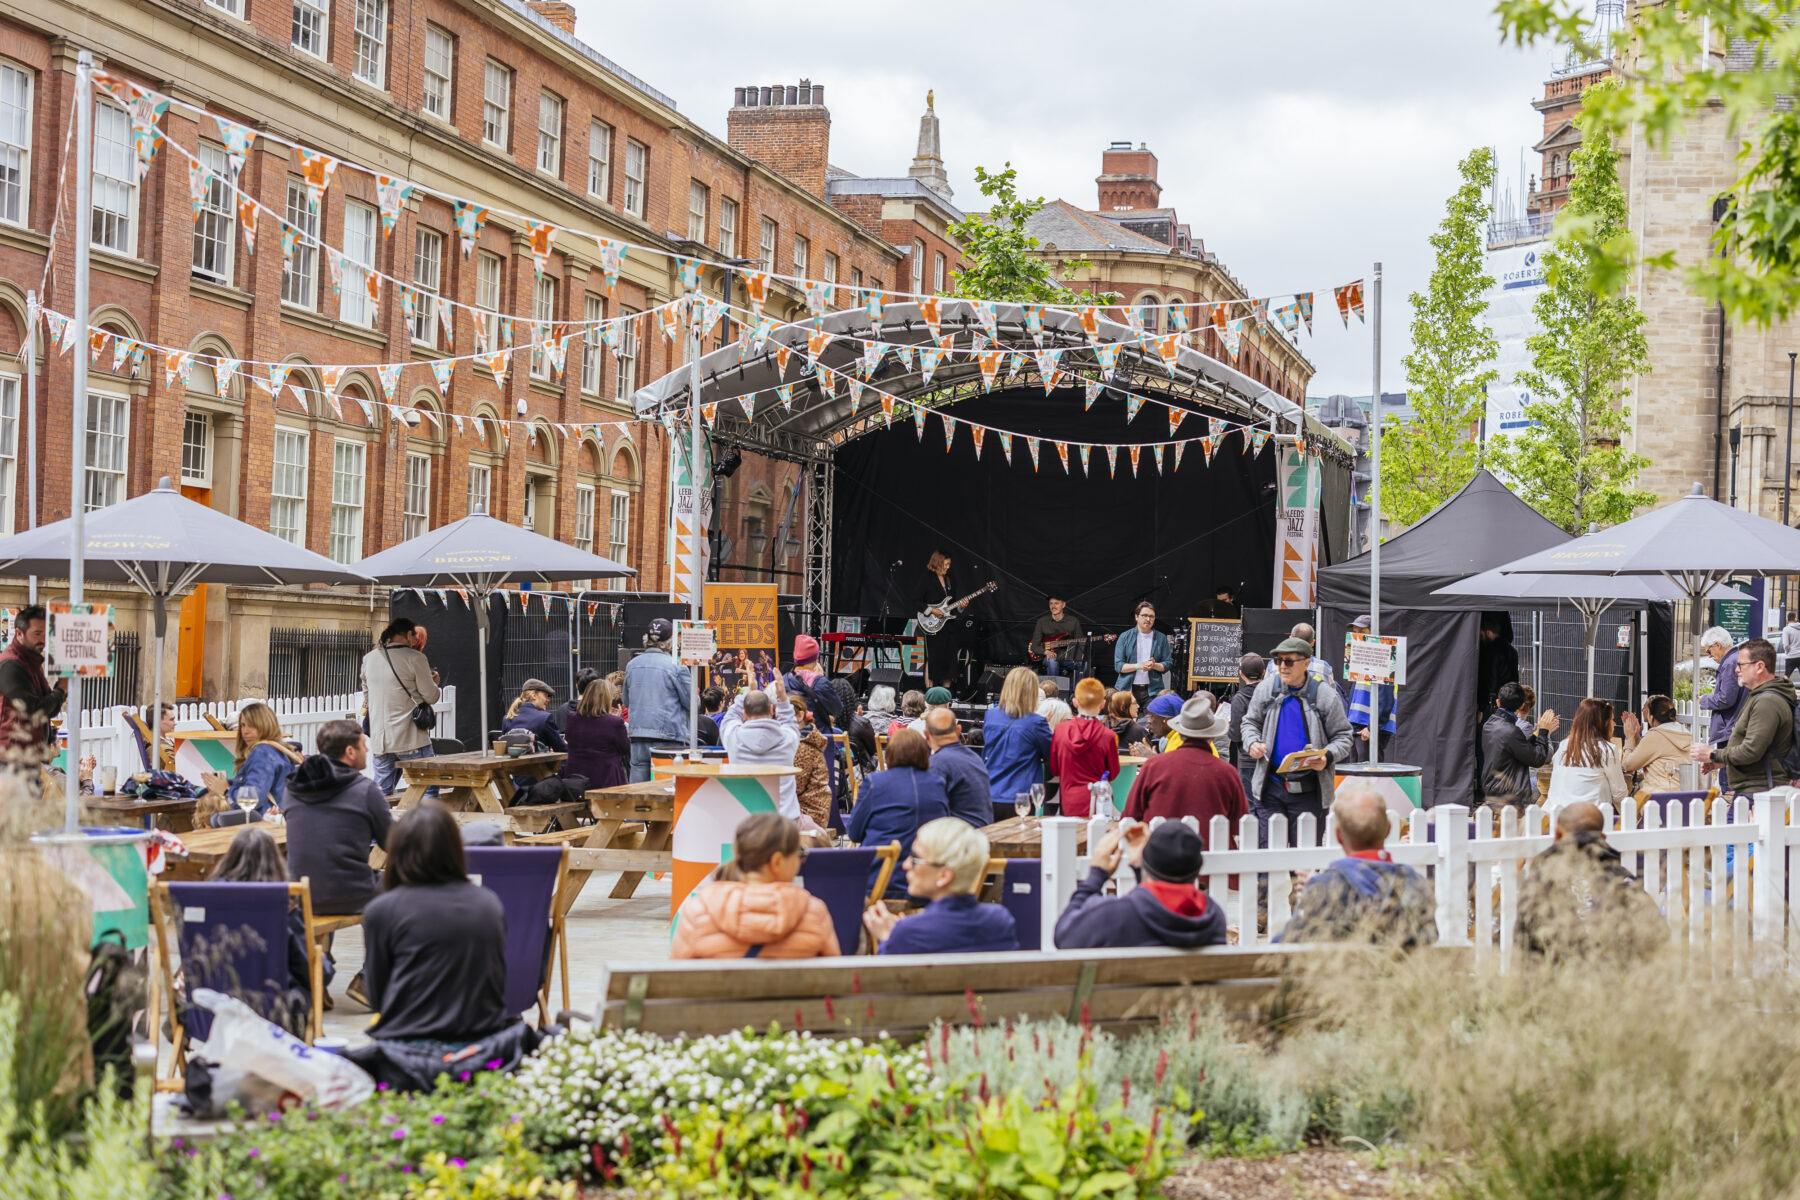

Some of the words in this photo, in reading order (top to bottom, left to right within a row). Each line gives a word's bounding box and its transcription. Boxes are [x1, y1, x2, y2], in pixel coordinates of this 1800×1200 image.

[1504, 269, 1538, 281] ROBERT
[678, 496, 692, 508] JAZ
[1287, 509, 1304, 517] LEEDS
[1287, 518, 1304, 531] JAZZ
[86, 540, 171, 550] ROWNS
[434, 555, 512, 564] BROWNS
[708, 597, 774, 621] JAZZ
[62, 629, 84, 642] LEEDS
[85, 629, 102, 643] JAZZ
[717, 623, 775, 645] EEDS
[65, 645, 97, 658] FESTIVAL
